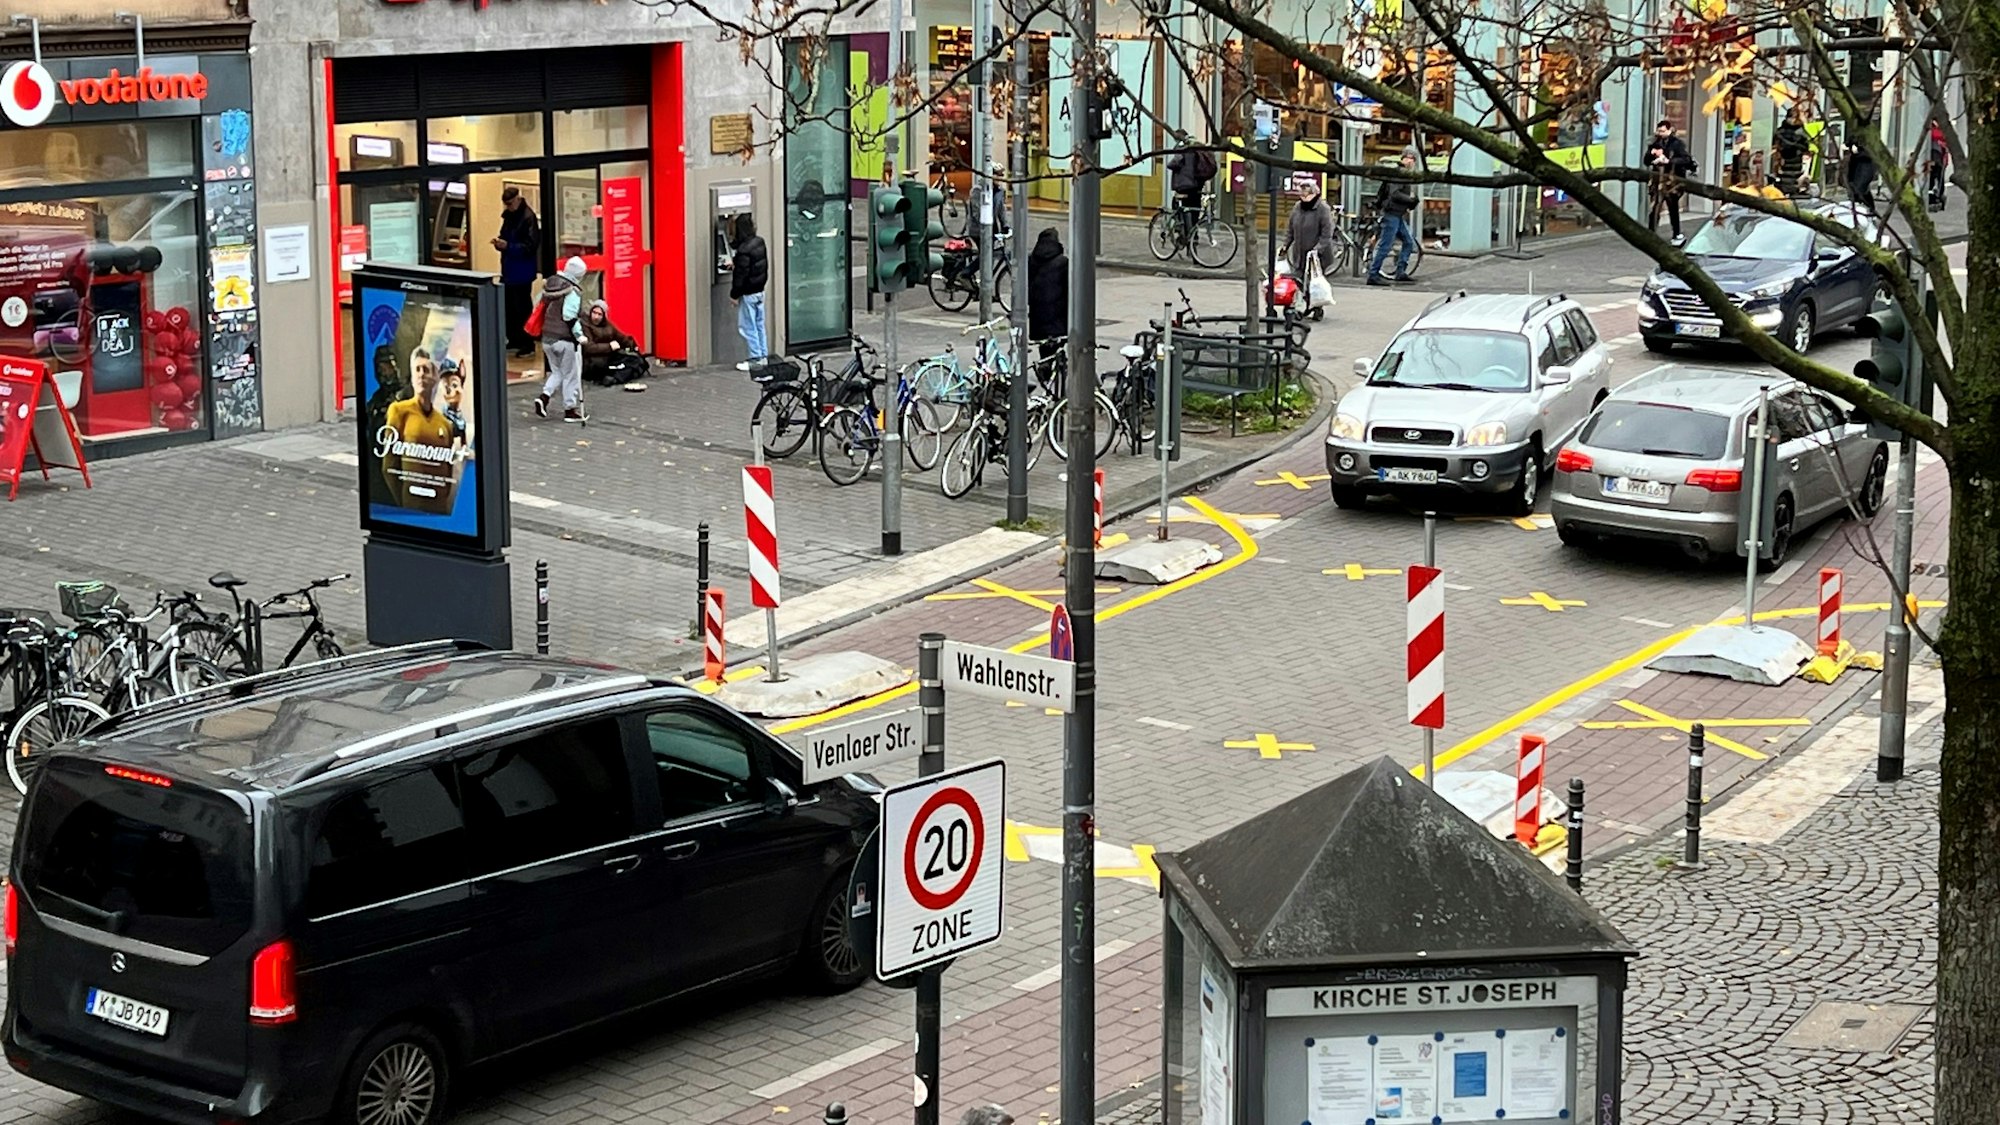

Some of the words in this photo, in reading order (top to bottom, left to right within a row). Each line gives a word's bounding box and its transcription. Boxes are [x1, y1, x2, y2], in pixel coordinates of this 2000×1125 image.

[58, 66, 208, 105] vodafone
[373, 425, 470, 464] Paramount+
[956, 652, 1061, 699] Wahlenstr.
[813, 732, 881, 770] Venloer
[885, 721, 917, 751] Str.
[923, 817, 969, 881] 20
[911, 908, 973, 955] ZONE
[98, 994, 109, 1014] K
[116, 1000, 134, 1021] JB
[135, 1006, 161, 1028] 919
[1313, 987, 1408, 1009] KIRCHE
[1417, 985, 1451, 1004] ST.
[1456, 981, 1557, 1003] JOSEPH
